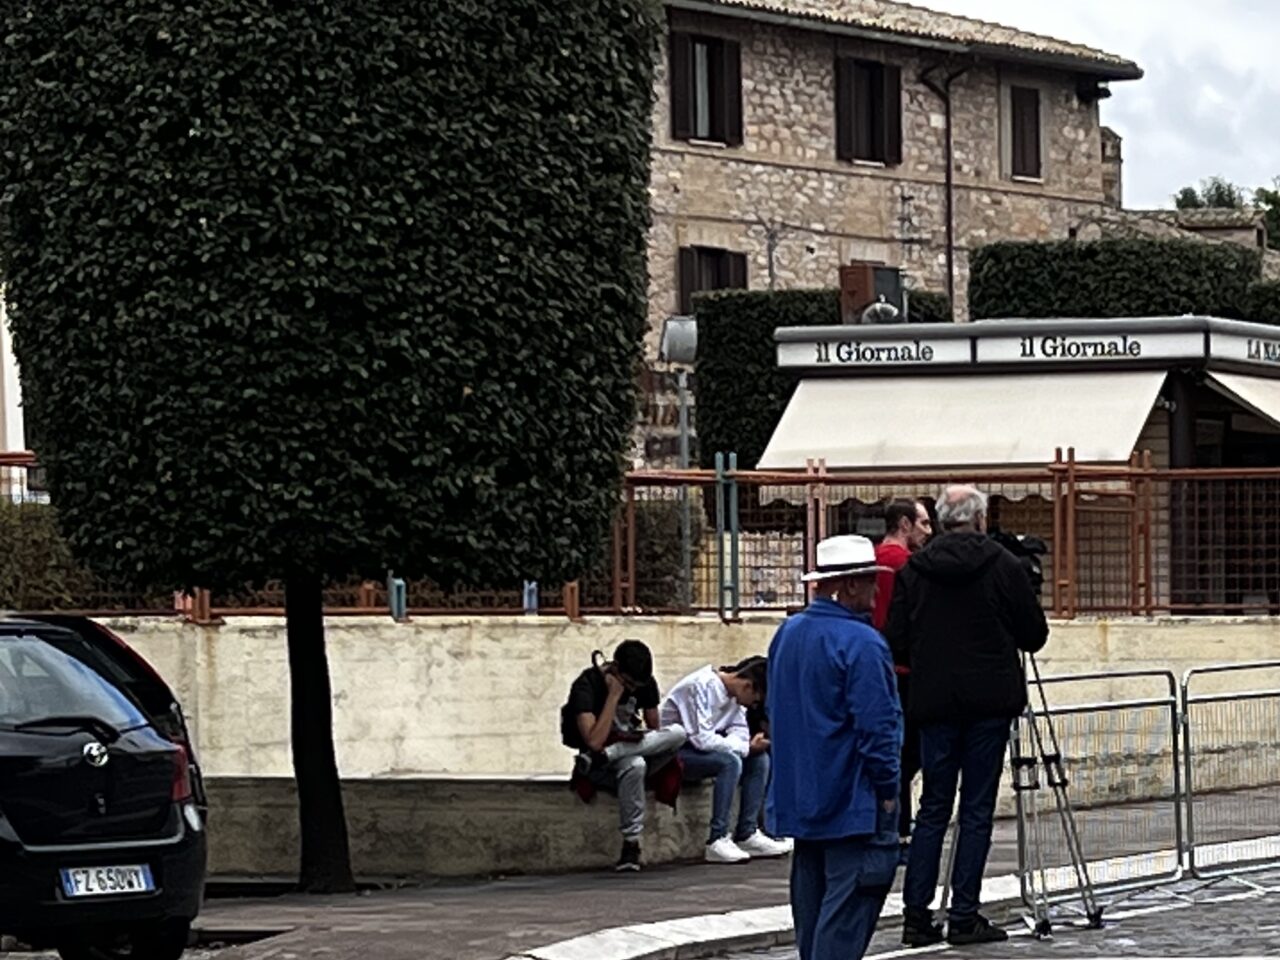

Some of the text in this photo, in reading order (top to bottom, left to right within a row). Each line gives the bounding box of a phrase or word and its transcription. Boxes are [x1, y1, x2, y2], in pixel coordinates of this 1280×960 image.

[815, 340, 934, 363] il Giornale
[1020, 335, 1142, 358] il Giornale
[1247, 339, 1261, 360] LA
